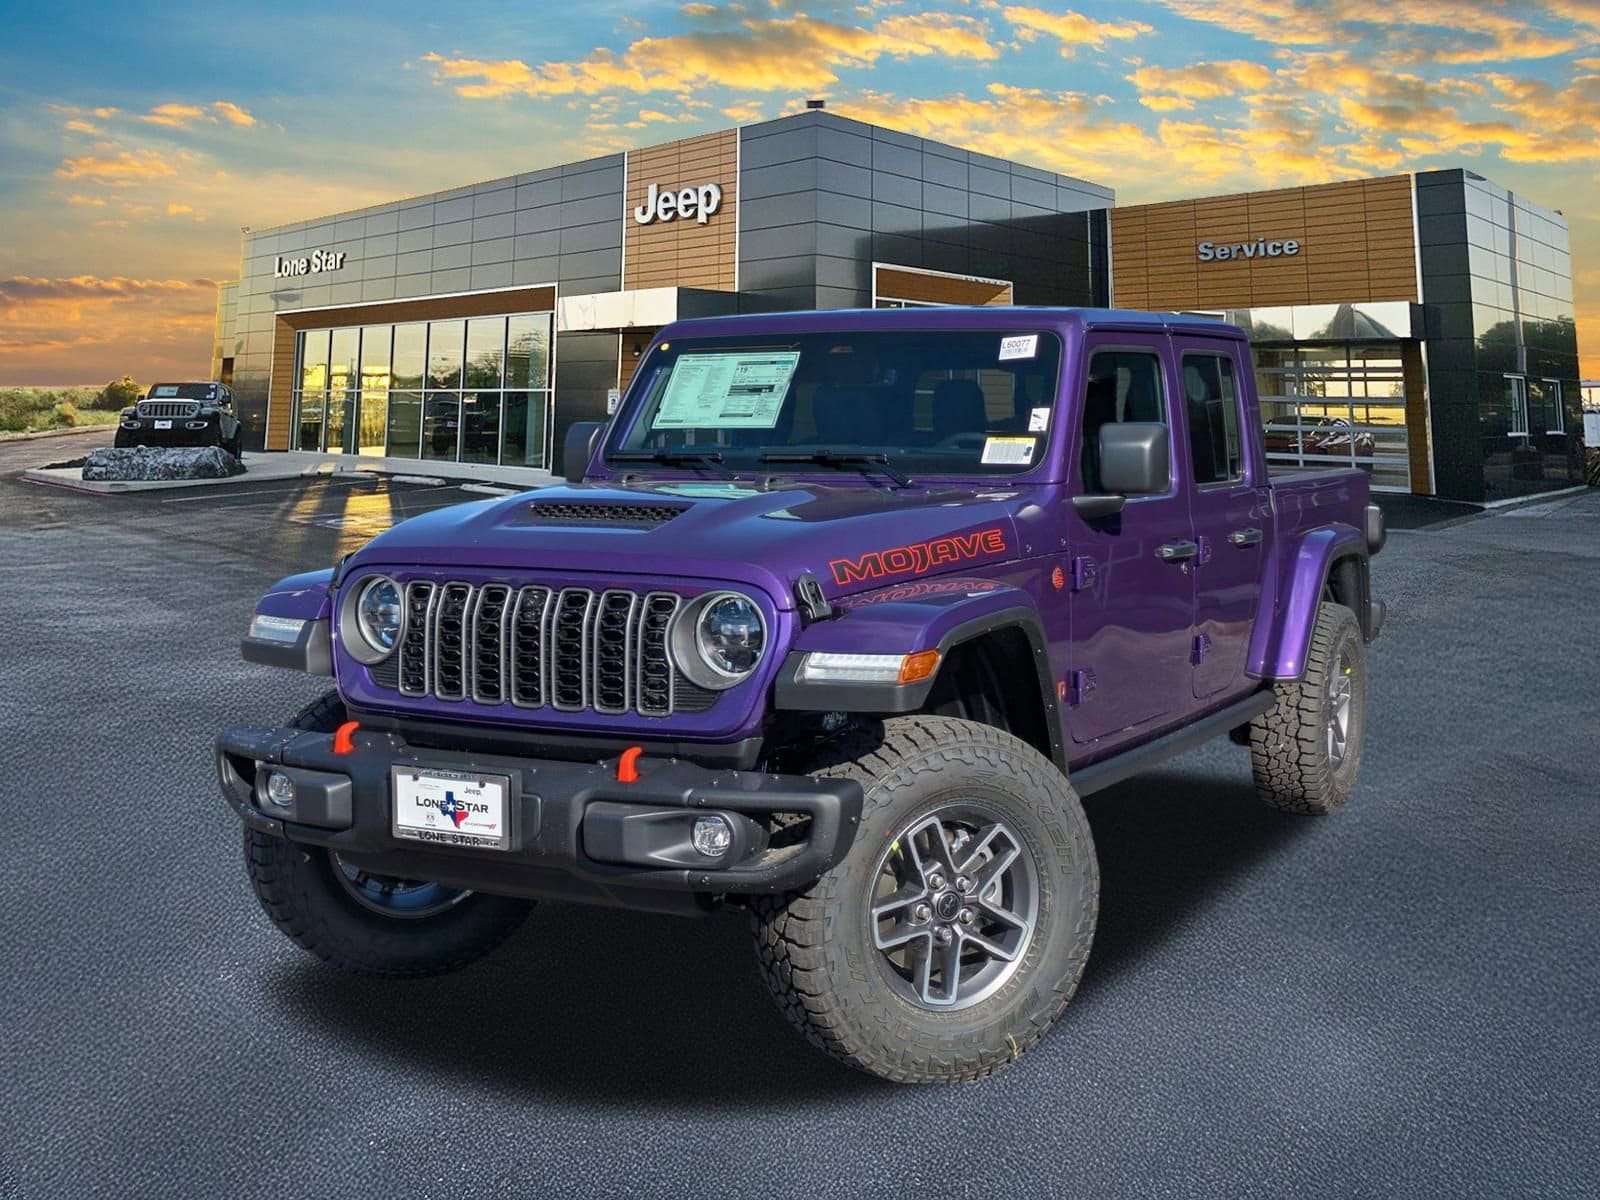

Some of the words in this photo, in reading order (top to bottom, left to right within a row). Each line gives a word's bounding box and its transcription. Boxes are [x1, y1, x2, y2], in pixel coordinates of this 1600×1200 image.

[634, 183, 722, 224] Jeep
[1198, 236, 1300, 261] Service
[275, 257, 310, 278] Lone
[311, 249, 346, 273] Star
[829, 528, 1006, 585] MOJAVE
[416, 796, 447, 809] LONE
[456, 800, 488, 813] STAR
[419, 831, 447, 842] LONE
[452, 834, 480, 846] STAR
